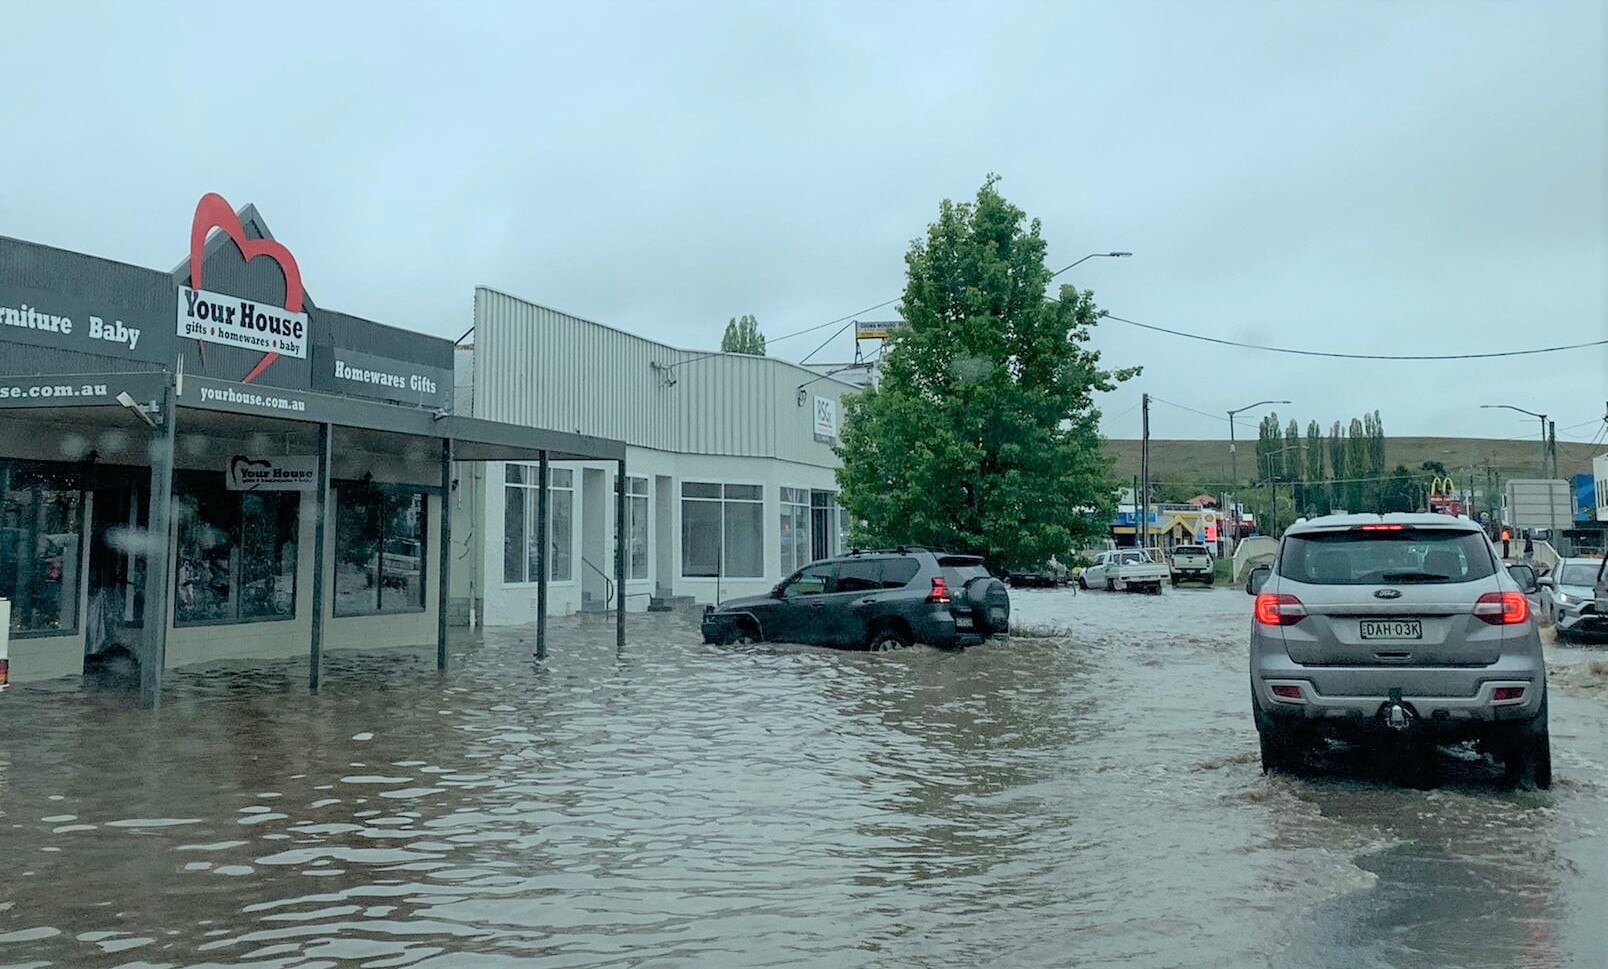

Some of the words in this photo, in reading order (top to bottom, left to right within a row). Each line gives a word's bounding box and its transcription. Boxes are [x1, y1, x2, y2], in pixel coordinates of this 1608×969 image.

[185, 289, 236, 326] Your
[240, 302, 303, 339] House
[88, 315, 141, 350] Baby
[185, 321, 207, 335] gifts
[218, 327, 270, 347] homewares
[279, 339, 300, 354] baby
[0, 383, 108, 398] se.com.au
[334, 360, 406, 389] Homewares
[410, 374, 437, 394] Gifts
[200, 387, 306, 411] yourhouse.com.au
[240, 468, 270, 479] Your
[273, 468, 313, 478] House
